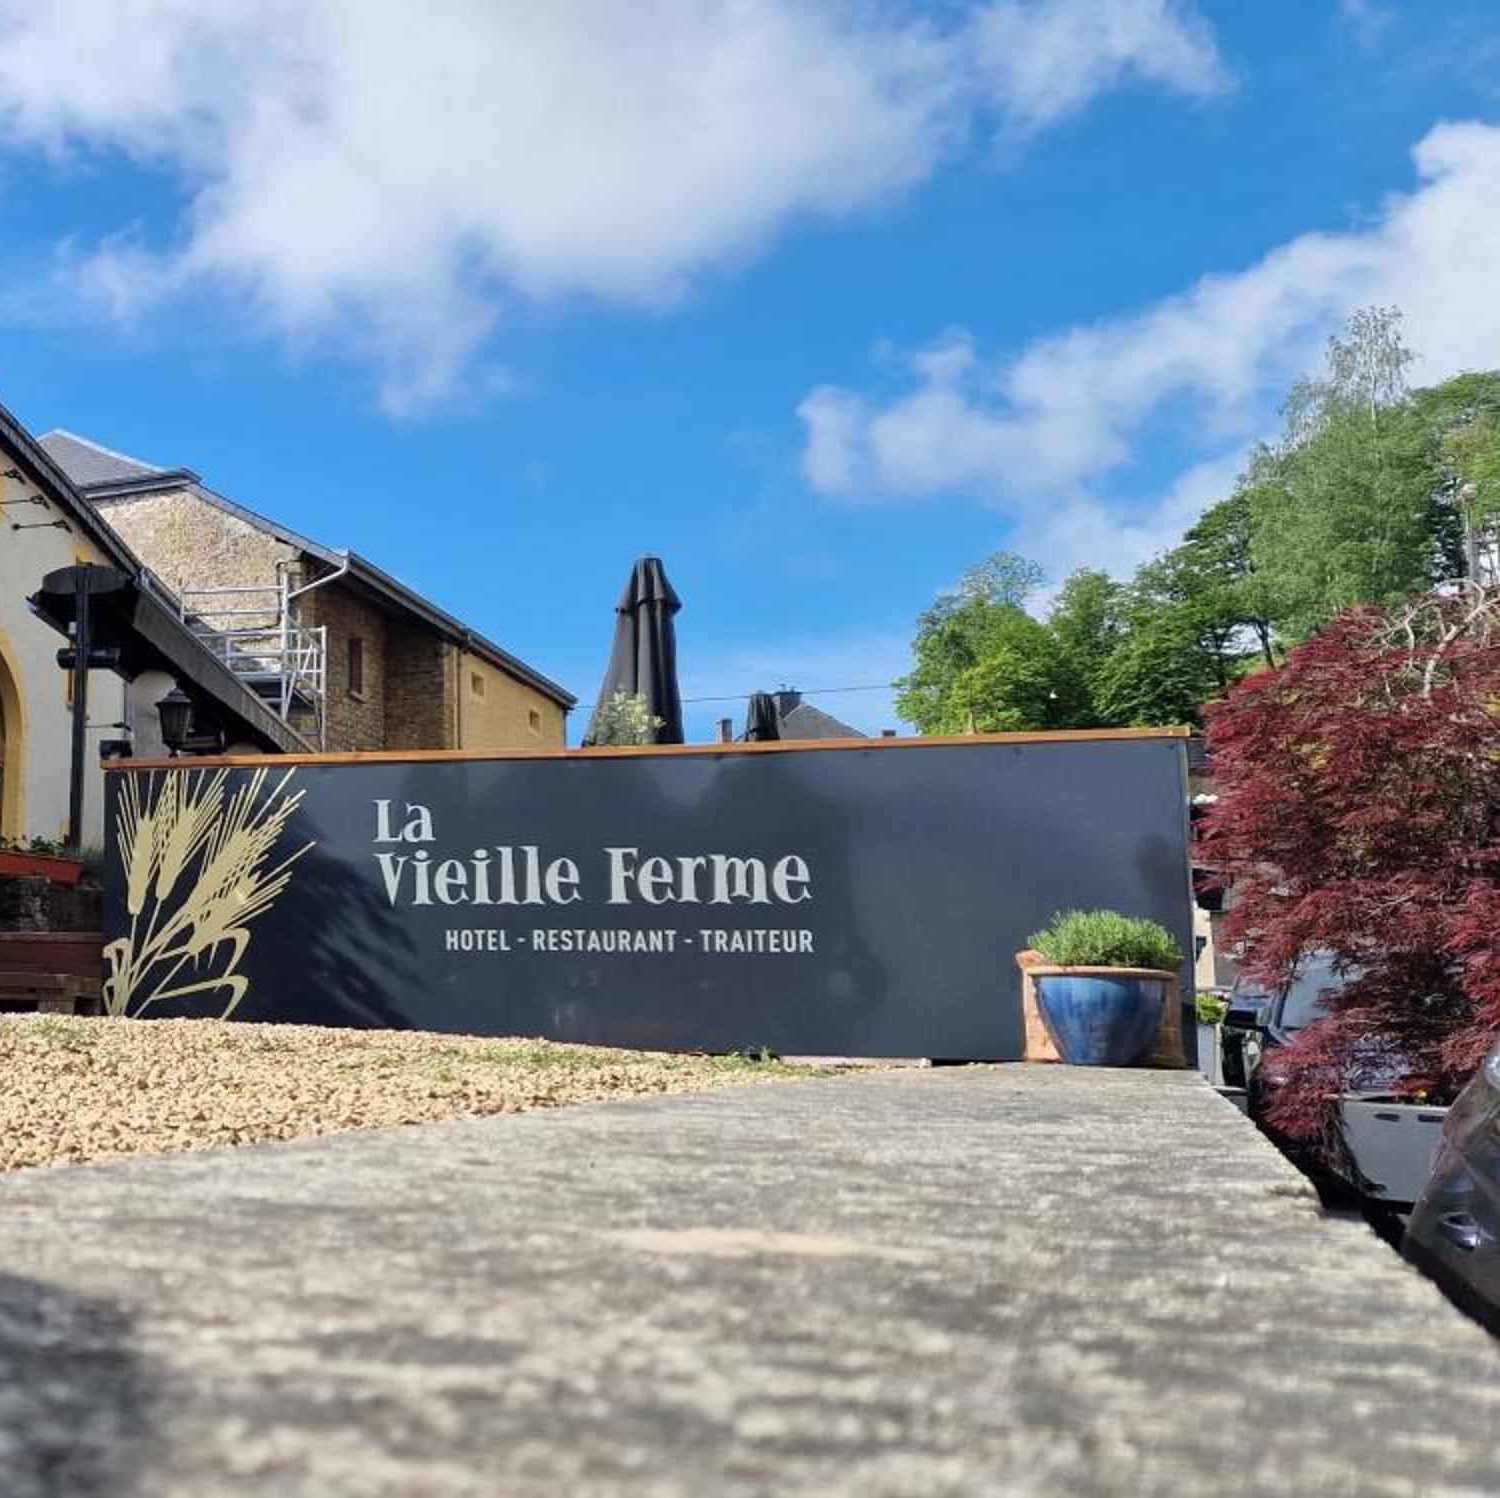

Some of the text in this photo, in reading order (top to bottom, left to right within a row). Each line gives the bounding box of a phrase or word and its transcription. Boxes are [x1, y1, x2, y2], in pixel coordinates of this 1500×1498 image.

[371, 799, 437, 843] La
[372, 845, 813, 906] Vieille Ferme
[445, 929, 511, 951] HOTEL
[532, 929, 677, 953] RESTAURANT
[699, 929, 815, 954] TRAITEUR
